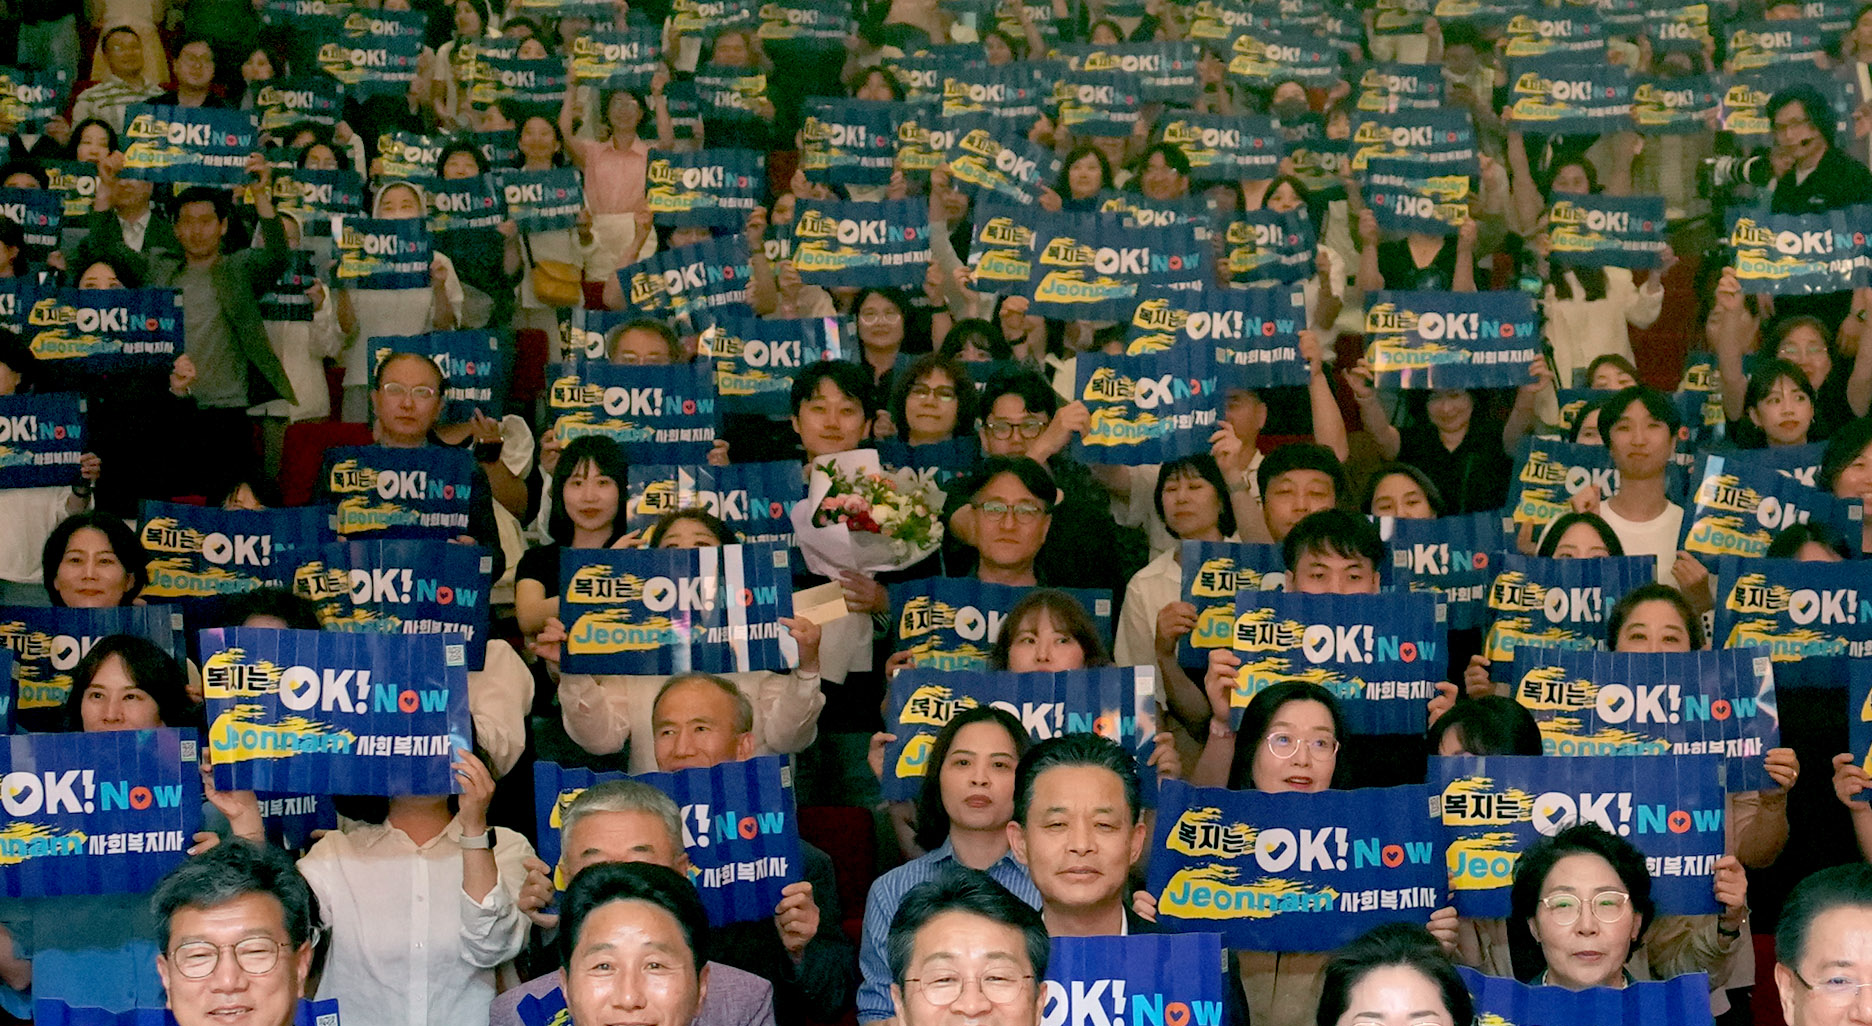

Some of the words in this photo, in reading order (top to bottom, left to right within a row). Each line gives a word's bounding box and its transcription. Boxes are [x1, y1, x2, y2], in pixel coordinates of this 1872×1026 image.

[837, 218, 886, 245] OK!
[1776, 230, 1833, 255] OK!
[76, 308, 128, 332] OK!
[1185, 309, 1242, 341] OK!
[1417, 312, 1479, 340] OK!
[602, 385, 662, 417] OK!
[377, 470, 427, 499] OK!
[203, 533, 270, 566] OK!
[295, 570, 347, 597] 복지는
[349, 569, 411, 605] OK!
[573, 579, 632, 597] 복지는
[642, 576, 715, 612] OK!
[1734, 588, 1788, 608] 복지는
[1789, 589, 1857, 625] OK!
[1236, 622, 1293, 646] 복지는
[1303, 625, 1374, 664] OK!
[206, 665, 268, 692] 복지는
[279, 665, 370, 714] OK!
[1522, 680, 1587, 704] 복지는
[1597, 683, 1681, 724] OK!
[213, 724, 350, 755] Jeonnam
[356, 734, 451, 757] 사회복지사
[1, 769, 95, 818] OK!
[1444, 794, 1520, 820] 복지는
[1532, 792, 1632, 837] OK!
[87, 830, 184, 855] 사회복지사
[1178, 822, 1244, 852] 복지는
[1254, 827, 1349, 873] OK!
[703, 858, 788, 888] 사회복지사
[1646, 855, 1722, 877] 회복지사
[1169, 882, 1333, 913] Jeonnam
[1339, 887, 1437, 914] 사회복지사
